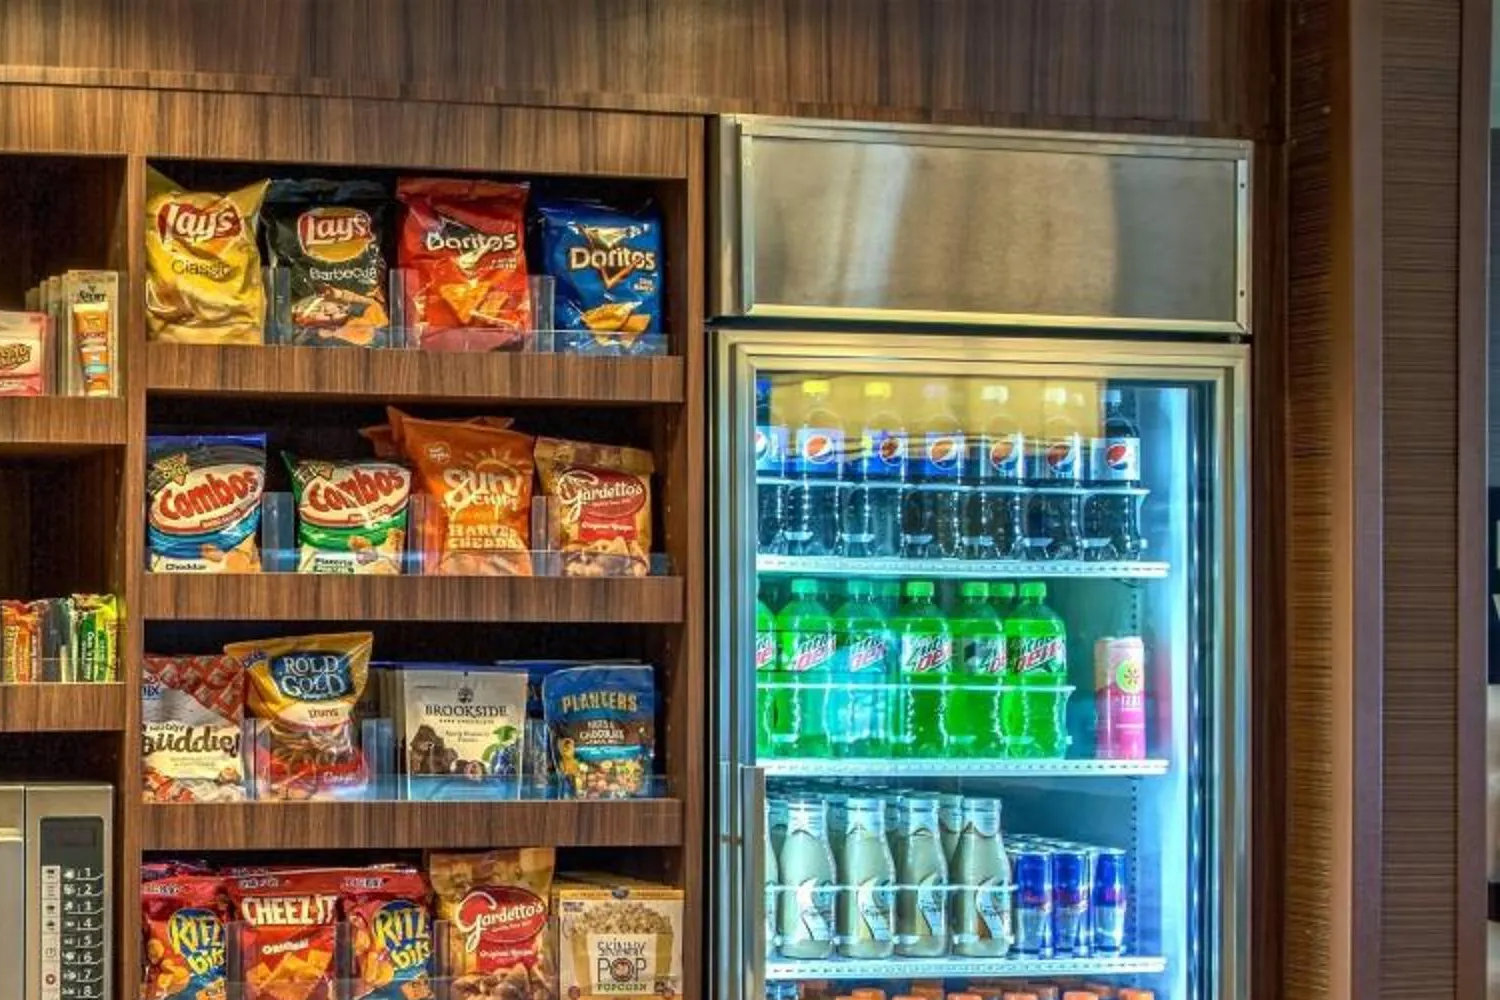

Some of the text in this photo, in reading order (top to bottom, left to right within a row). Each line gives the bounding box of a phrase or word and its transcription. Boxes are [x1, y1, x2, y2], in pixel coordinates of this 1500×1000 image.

[426, 231, 517, 251] Doritos
[571, 247, 656, 272] Doritos
[159, 468, 257, 521] Combos
[308, 468, 405, 513] Combos
[284, 656, 340, 674] ROLD
[281, 674, 346, 698] GOLD
[425, 704, 508, 718] BROOKSIDE
[562, 691, 638, 714] PLANTERS
[456, 891, 544, 952] Gardetto's
[597, 957, 647, 983] POP
